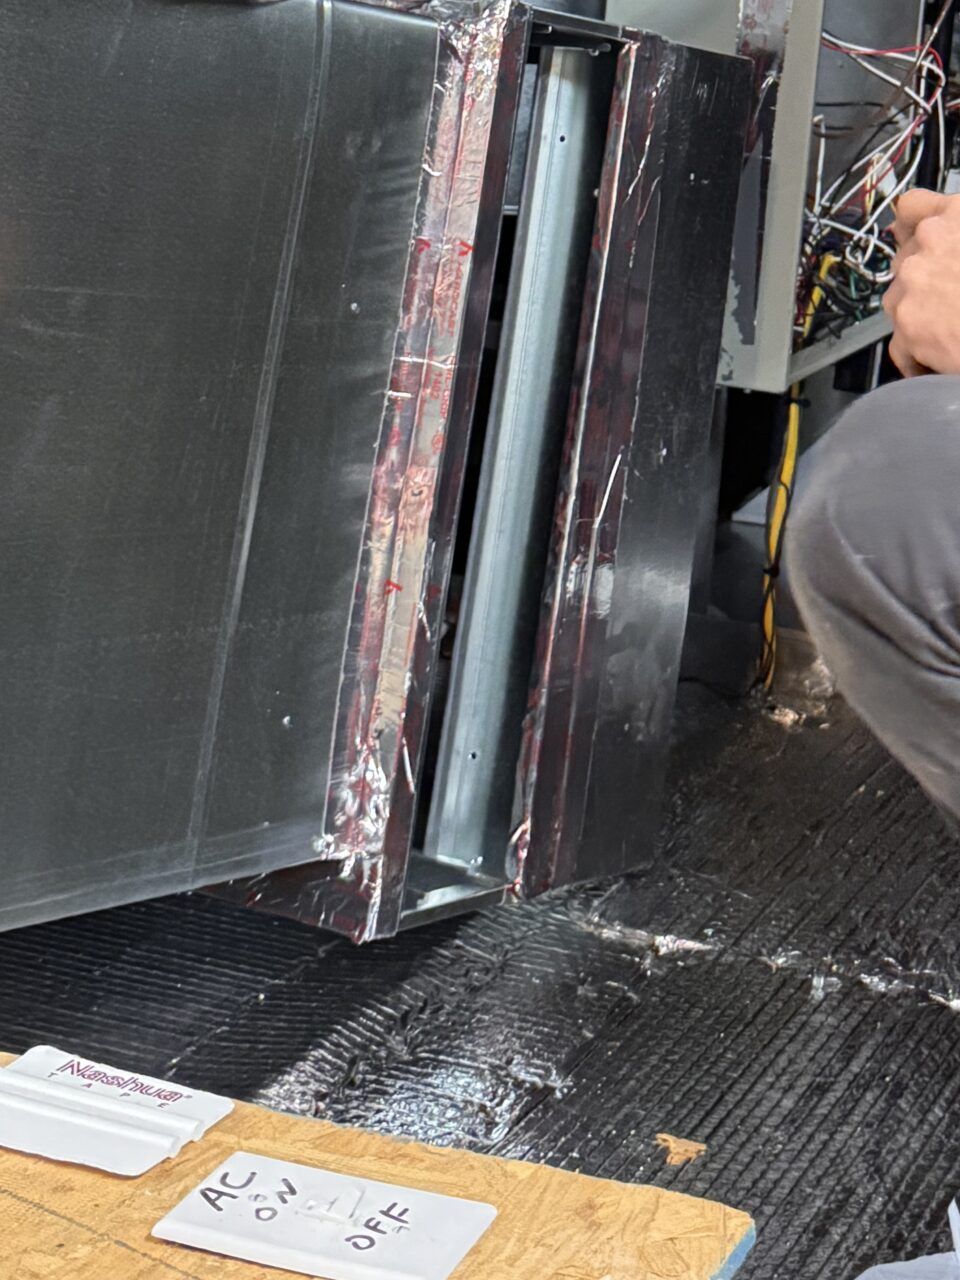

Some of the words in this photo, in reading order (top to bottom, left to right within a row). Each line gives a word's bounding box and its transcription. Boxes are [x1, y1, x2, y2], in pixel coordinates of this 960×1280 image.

[56, 1059, 184, 1103] Nashua
[200, 1170, 258, 1212] AC
[254, 1178, 298, 1222] ON
[344, 1202, 410, 1251] OFF
